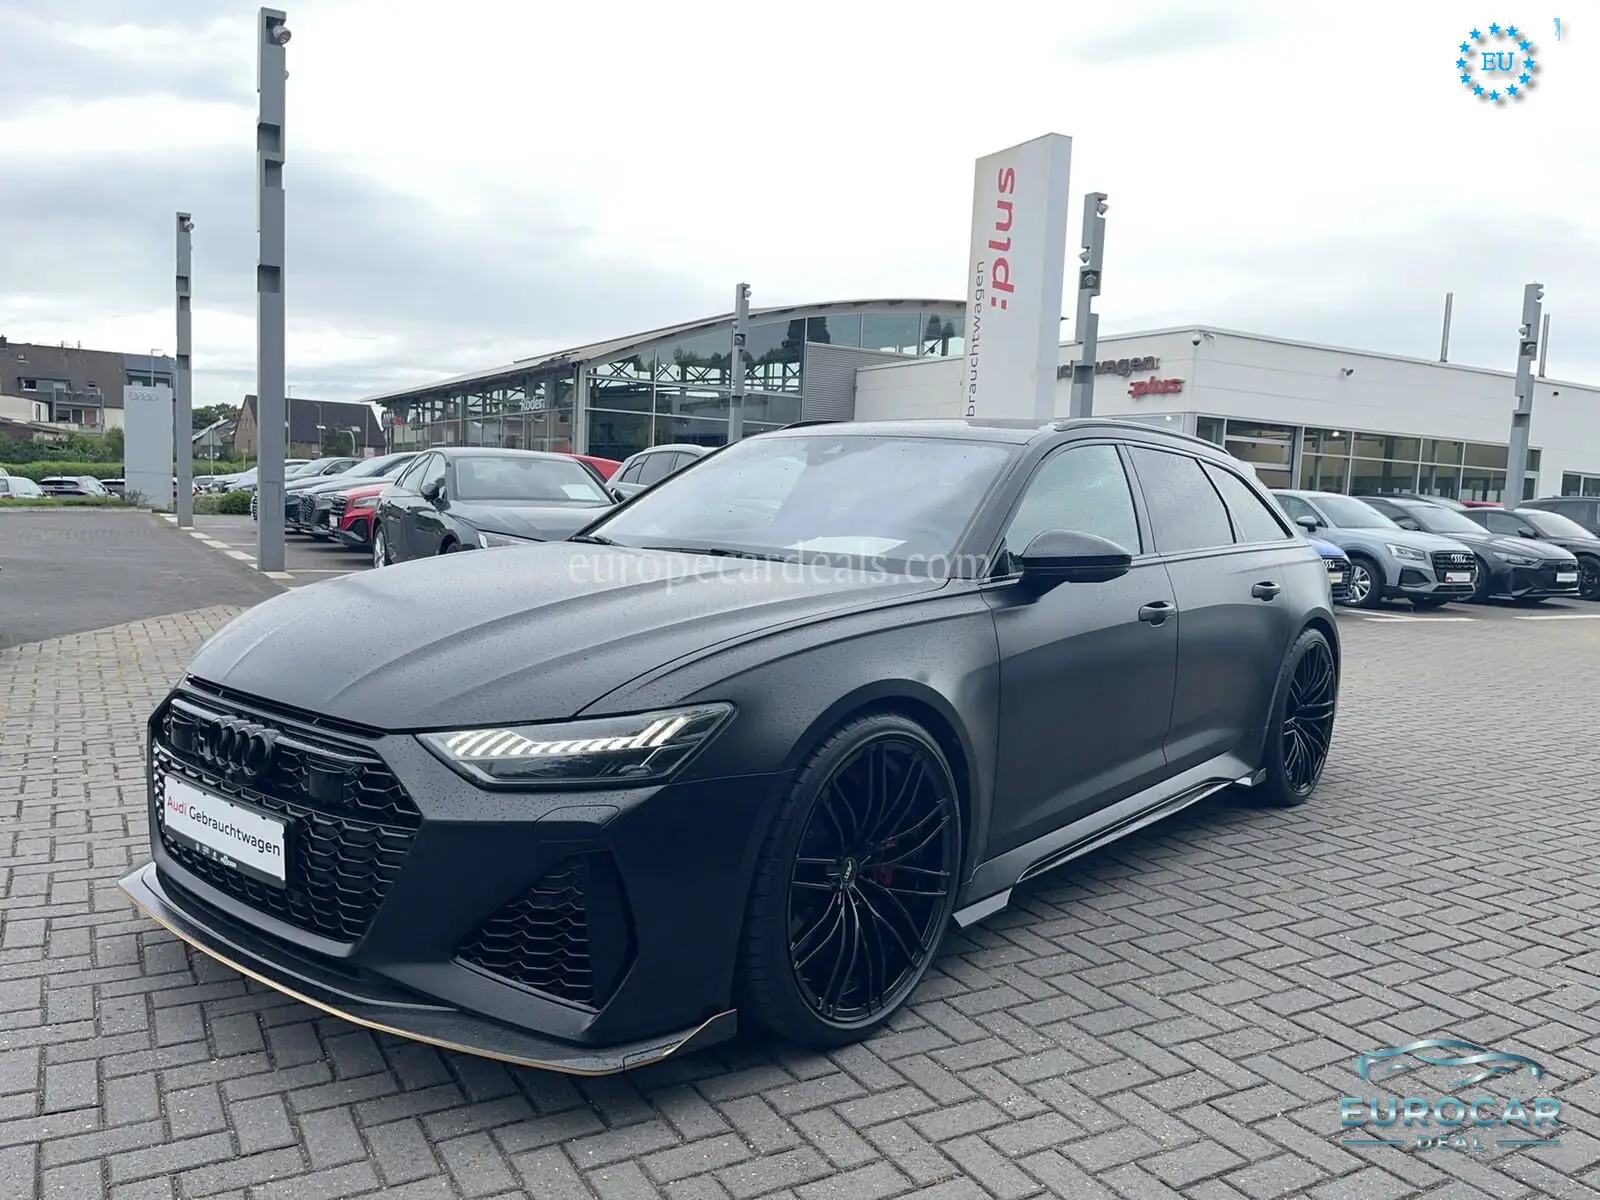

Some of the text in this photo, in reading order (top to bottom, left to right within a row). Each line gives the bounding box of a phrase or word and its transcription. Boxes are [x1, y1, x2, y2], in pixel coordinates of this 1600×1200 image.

[988, 167, 1015, 310] :plus
[167, 795, 187, 816] Audi
[188, 805, 281, 857] Gebrauchtwagen
